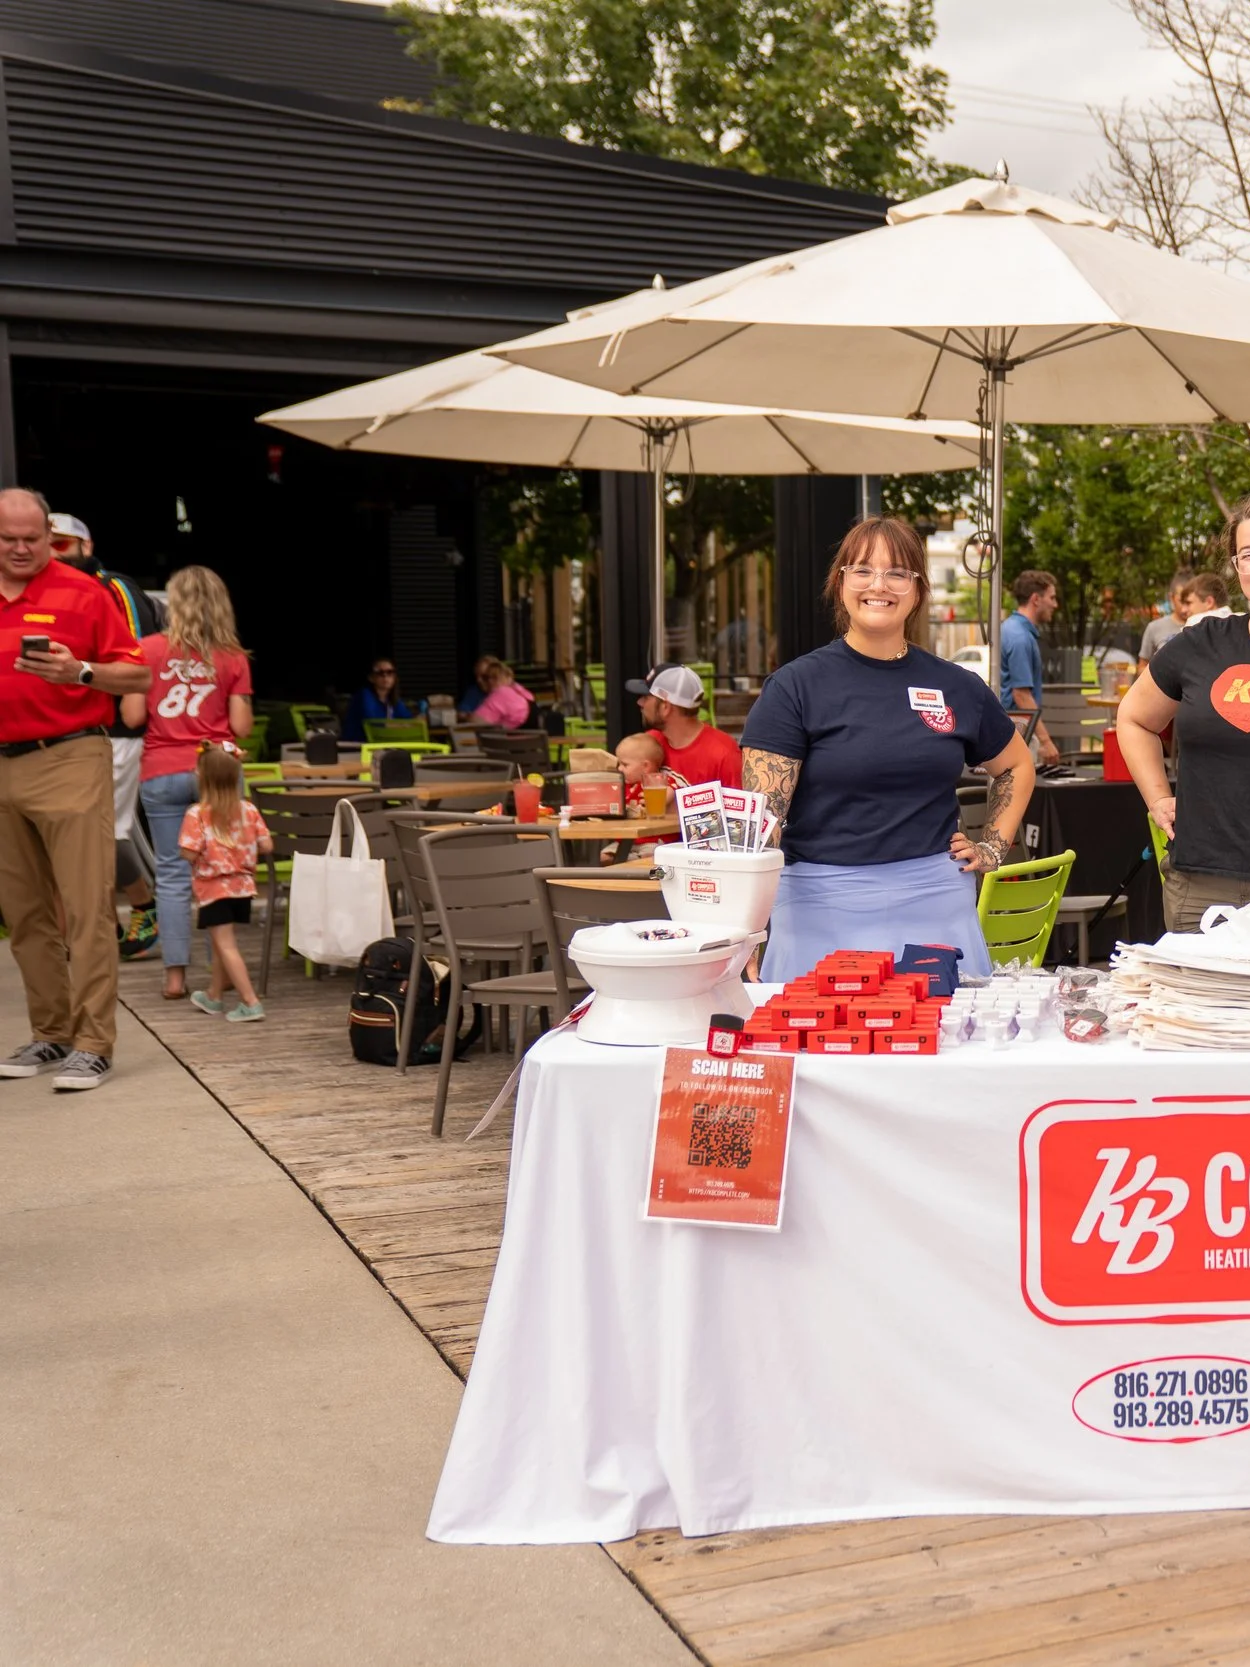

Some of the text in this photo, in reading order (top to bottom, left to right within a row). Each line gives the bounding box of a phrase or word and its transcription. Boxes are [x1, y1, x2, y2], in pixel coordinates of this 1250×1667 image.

[157, 683, 217, 718] 87
[692, 1059, 765, 1080] SCAN HERE
[681, 1081, 773, 1095] TO FOLLOW US ON FACEBOOK
[1071, 1147, 1190, 1275] KB
[1114, 1368, 1248, 1398] 816.271.0896
[1113, 1398, 1249, 1428] 913.289.4575
